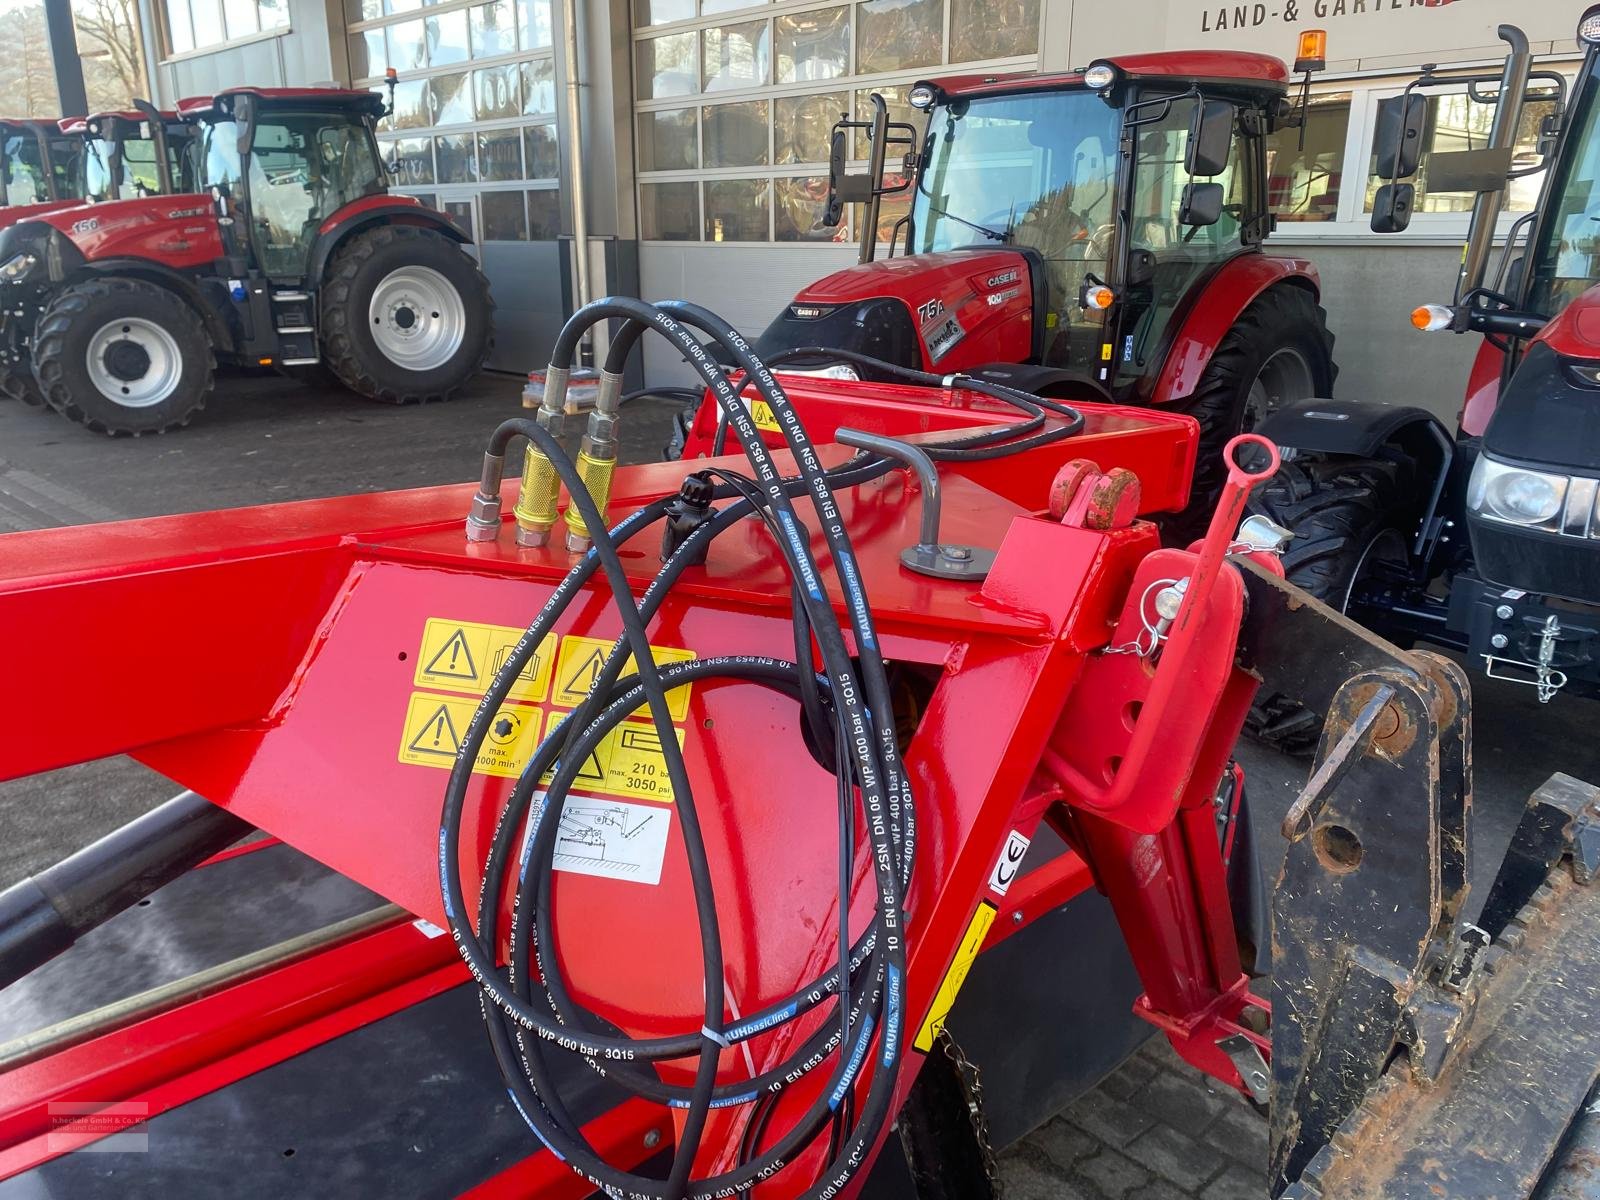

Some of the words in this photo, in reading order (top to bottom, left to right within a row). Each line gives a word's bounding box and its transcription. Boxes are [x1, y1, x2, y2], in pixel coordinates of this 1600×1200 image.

[72, 218, 98, 233] 150
[988, 272, 1010, 287] CASE
[678, 330, 693, 347] bar
[690, 344, 708, 362] 400
[748, 354, 764, 370] bar
[704, 362, 719, 380] WP
[759, 370, 774, 388] 400
[717, 380, 730, 394] 06
[725, 394, 740, 412] DN
[771, 389, 786, 408] WP
[784, 410, 797, 424] 06
[736, 415, 754, 438] 2SN
[790, 426, 806, 444] DN
[750, 442, 766, 464] 853
[801, 448, 818, 472] 2SN
[760, 464, 774, 481] EN
[770, 486, 782, 499] 10
[814, 477, 828, 498] 853
[822, 502, 836, 520] EN
[832, 525, 844, 540] 10
[528, 614, 544, 635] 2SN
[515, 638, 528, 654] DN
[506, 655, 516, 667] 06
[685, 660, 701, 671] DN
[706, 656, 730, 666] 2SN
[757, 656, 774, 666] EN
[779, 660, 792, 670] 10
[668, 666, 682, 676] 06
[481, 689, 493, 708] 400
[626, 684, 644, 699] 400
[840, 674, 856, 706] 3Q15
[608, 698, 626, 712] bar
[852, 713, 864, 735] bar
[488, 748, 508, 757] max.
[856, 738, 870, 761] 400
[882, 728, 895, 761] 3Q15
[609, 769, 628, 778] max.
[632, 762, 656, 776] 210
[660, 770, 670, 778] ba
[862, 766, 876, 788] WP
[626, 777, 656, 792] 3050
[658, 785, 670, 794] psi
[888, 770, 898, 792] bar
[869, 795, 880, 812] 06
[890, 796, 900, 819] 400
[872, 816, 885, 835] DN
[890, 824, 901, 844] WP
[906, 816, 915, 836] bar
[876, 843, 890, 872] 2SN
[904, 840, 914, 862] 400
[514, 894, 520, 906] 10
[886, 908, 896, 928] EN
[888, 936, 898, 951] 10
[452, 927, 461, 942] 10
[458, 945, 470, 962] EN
[468, 962, 482, 982] 853
[483, 984, 502, 1006] 2SN
[504, 1004, 520, 1022] DN
[520, 1016, 533, 1030] 06
[538, 1026, 556, 1042] WP
[557, 1035, 577, 1051] 400
[580, 1042, 599, 1056] bar
[605, 1048, 634, 1060] 3Q15
[808, 990, 821, 1004] 10
[768, 1082, 782, 1094] 10
[785, 1068, 804, 1084] EN
[804, 1054, 823, 1072] 853
[715, 1187, 735, 1200] 400
[736, 1178, 755, 1193] bar
[758, 1159, 785, 1180] 3Q15
[832, 1170, 850, 1188] bar
